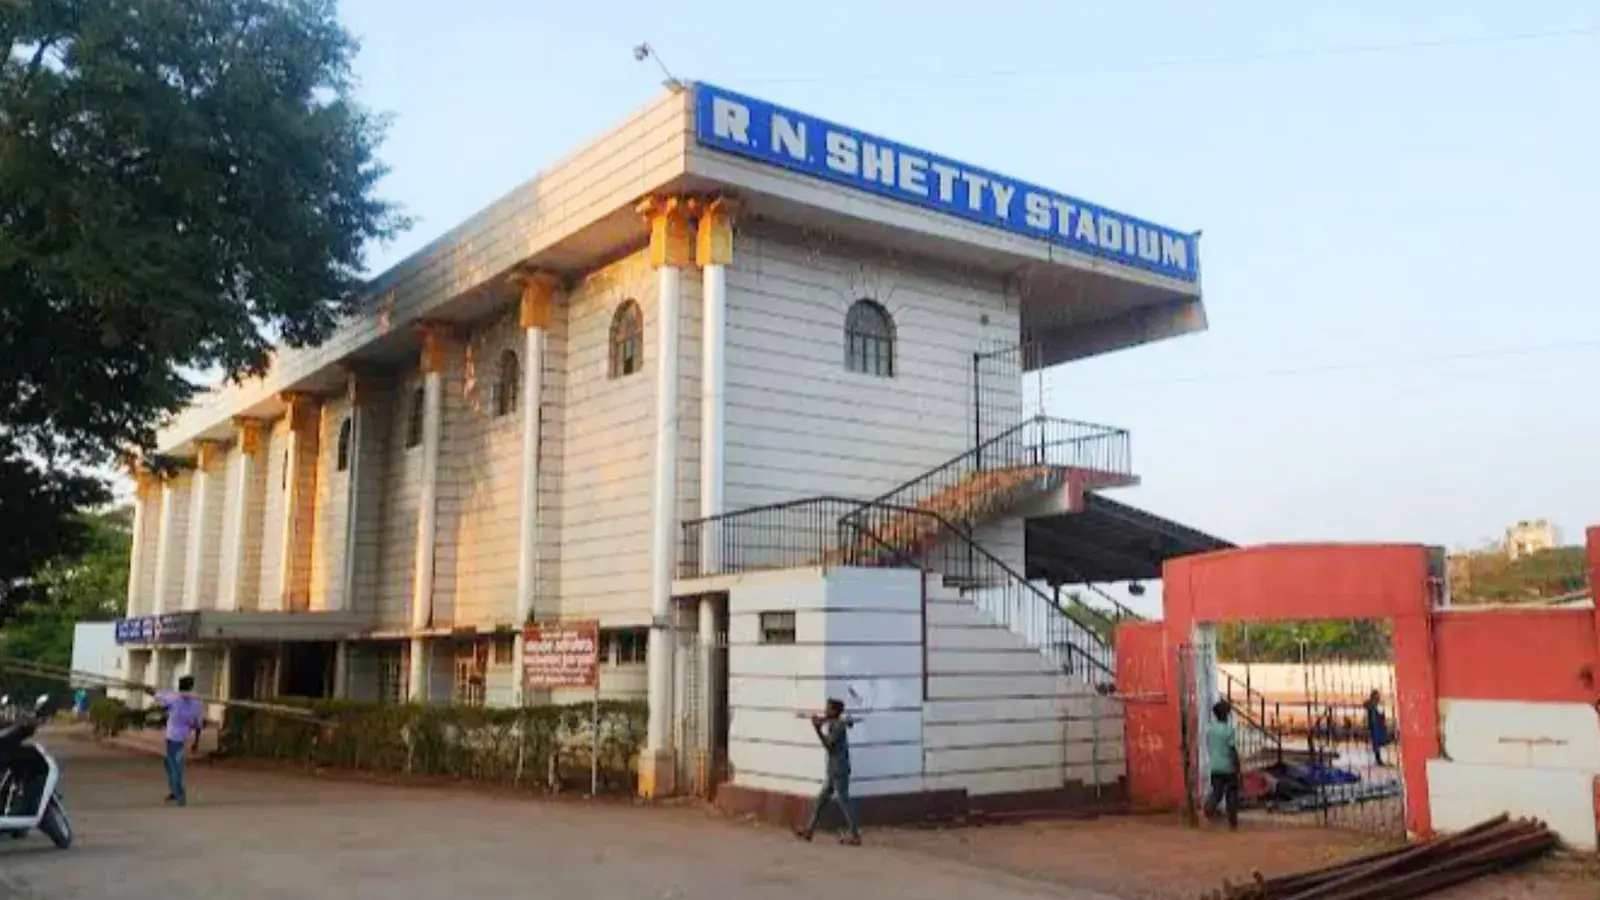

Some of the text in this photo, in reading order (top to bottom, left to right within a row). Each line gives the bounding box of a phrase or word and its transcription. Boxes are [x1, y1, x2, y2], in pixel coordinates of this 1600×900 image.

[713, 97, 757, 146] R.
[827, 132, 1015, 218] SHETTY
[1025, 194, 1187, 269] STADIUM
